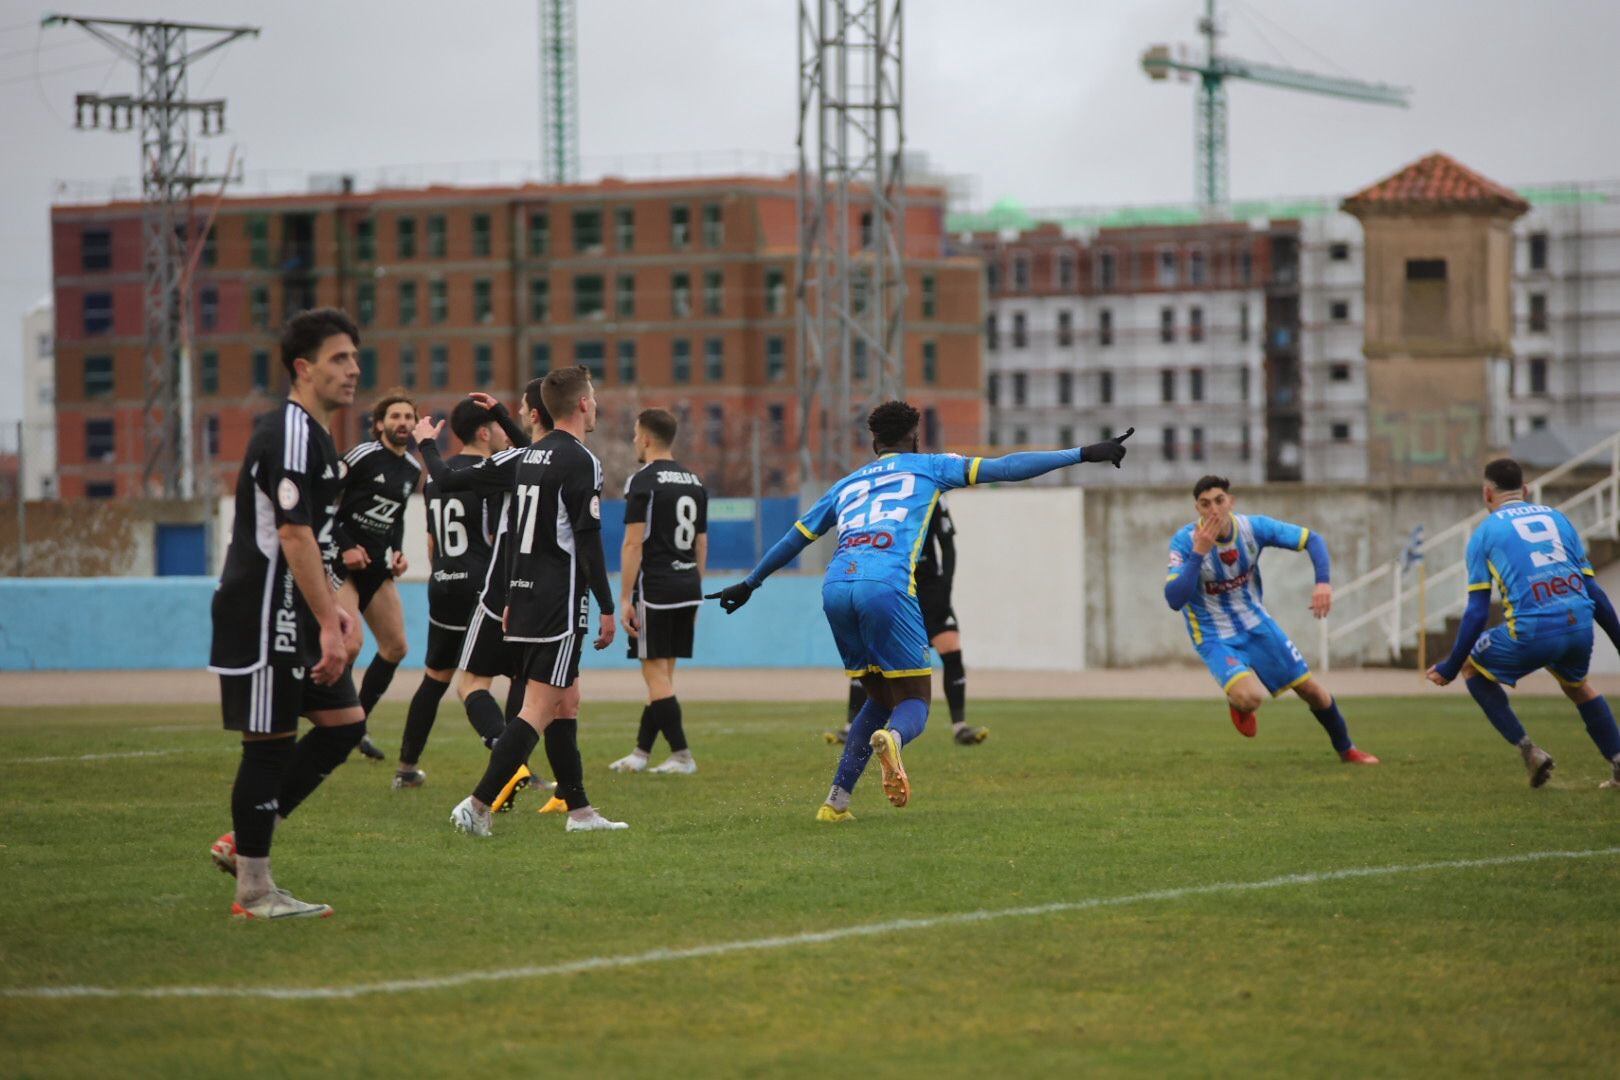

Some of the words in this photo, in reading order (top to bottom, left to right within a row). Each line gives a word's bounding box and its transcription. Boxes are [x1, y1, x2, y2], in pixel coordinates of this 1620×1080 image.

[429, 498, 469, 558] 16
[516, 484, 540, 554] 11
[674, 495, 698, 551] 8
[836, 472, 915, 538] 22
[1511, 514, 1568, 568] 9
[1531, 573, 1583, 602] neo
[274, 608, 297, 653] PJR
